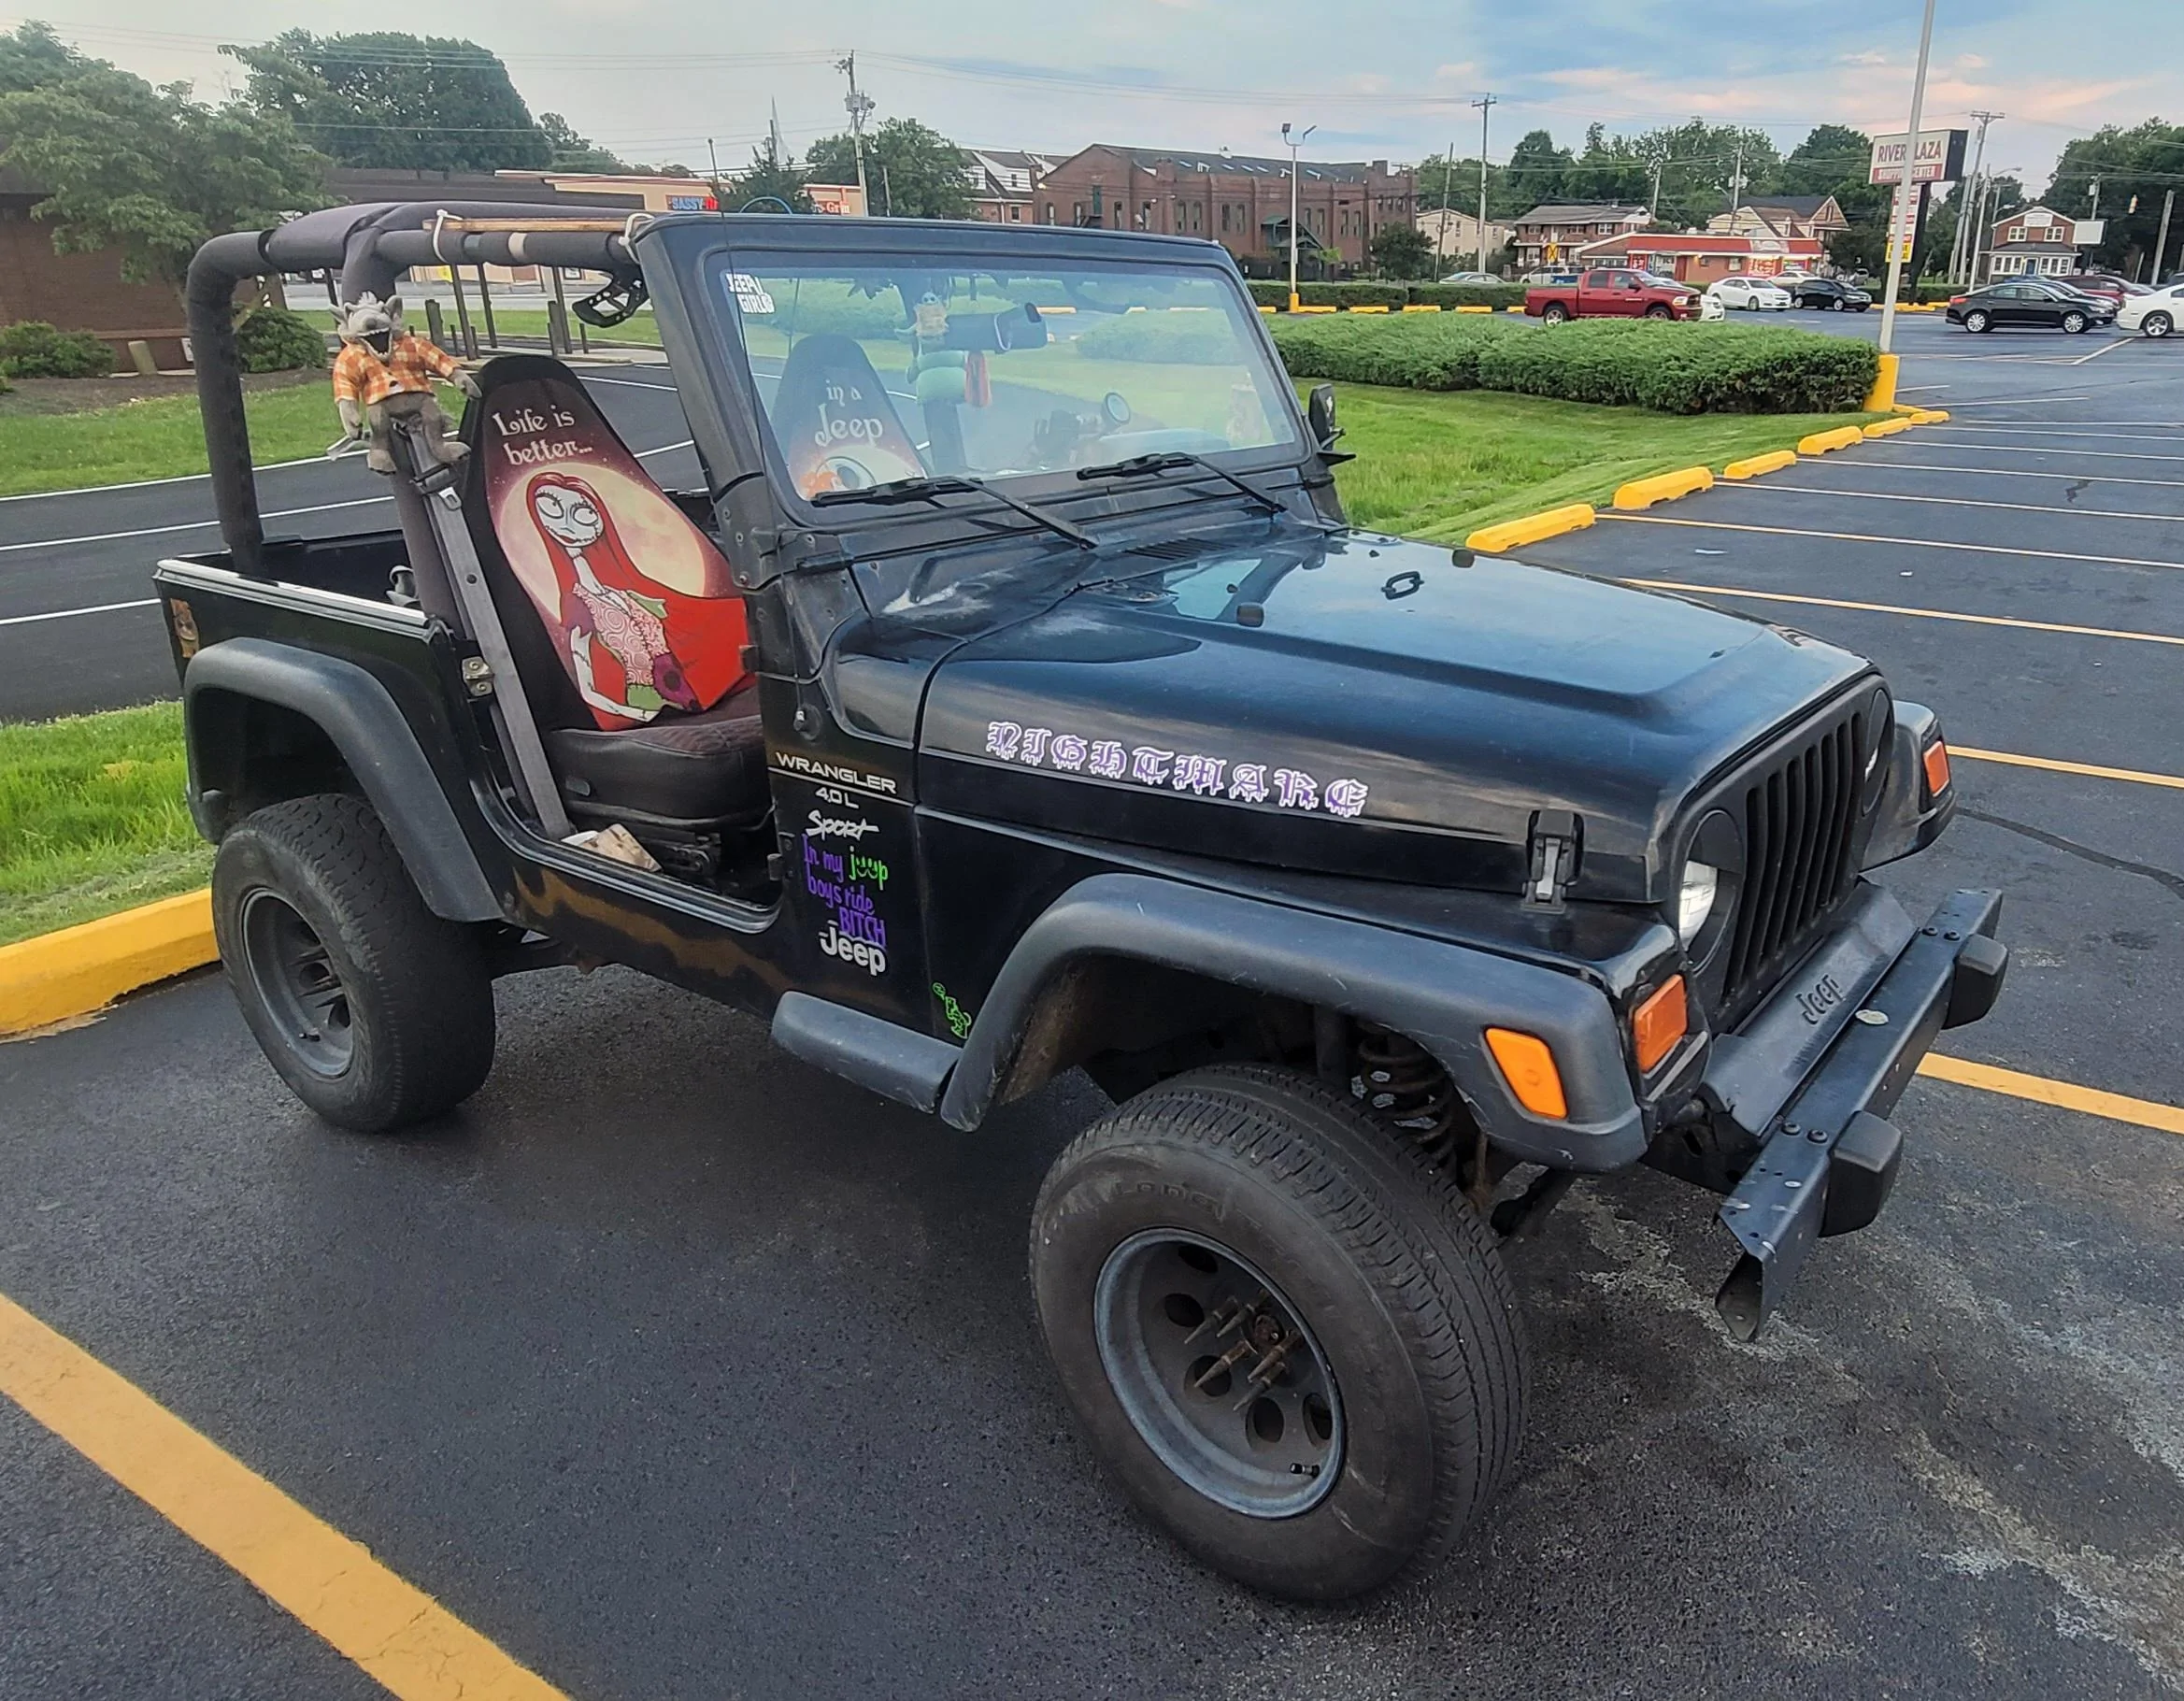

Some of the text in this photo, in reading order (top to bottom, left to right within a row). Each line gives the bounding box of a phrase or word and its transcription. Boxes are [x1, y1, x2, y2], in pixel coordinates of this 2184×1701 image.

[1877, 140, 1941, 163] RIVER LAZA
[825, 379, 863, 407] in a
[492, 404, 575, 436] Life is
[815, 403, 883, 448] Jeep
[776, 751, 897, 794] WRANGLER
[801, 834, 820, 866] In
[822, 850, 844, 883] my
[806, 861, 876, 915] boys ride
[818, 920, 886, 977] Jeep
[839, 906, 887, 949] BITCH
[1794, 974, 1845, 1025] Jeep
